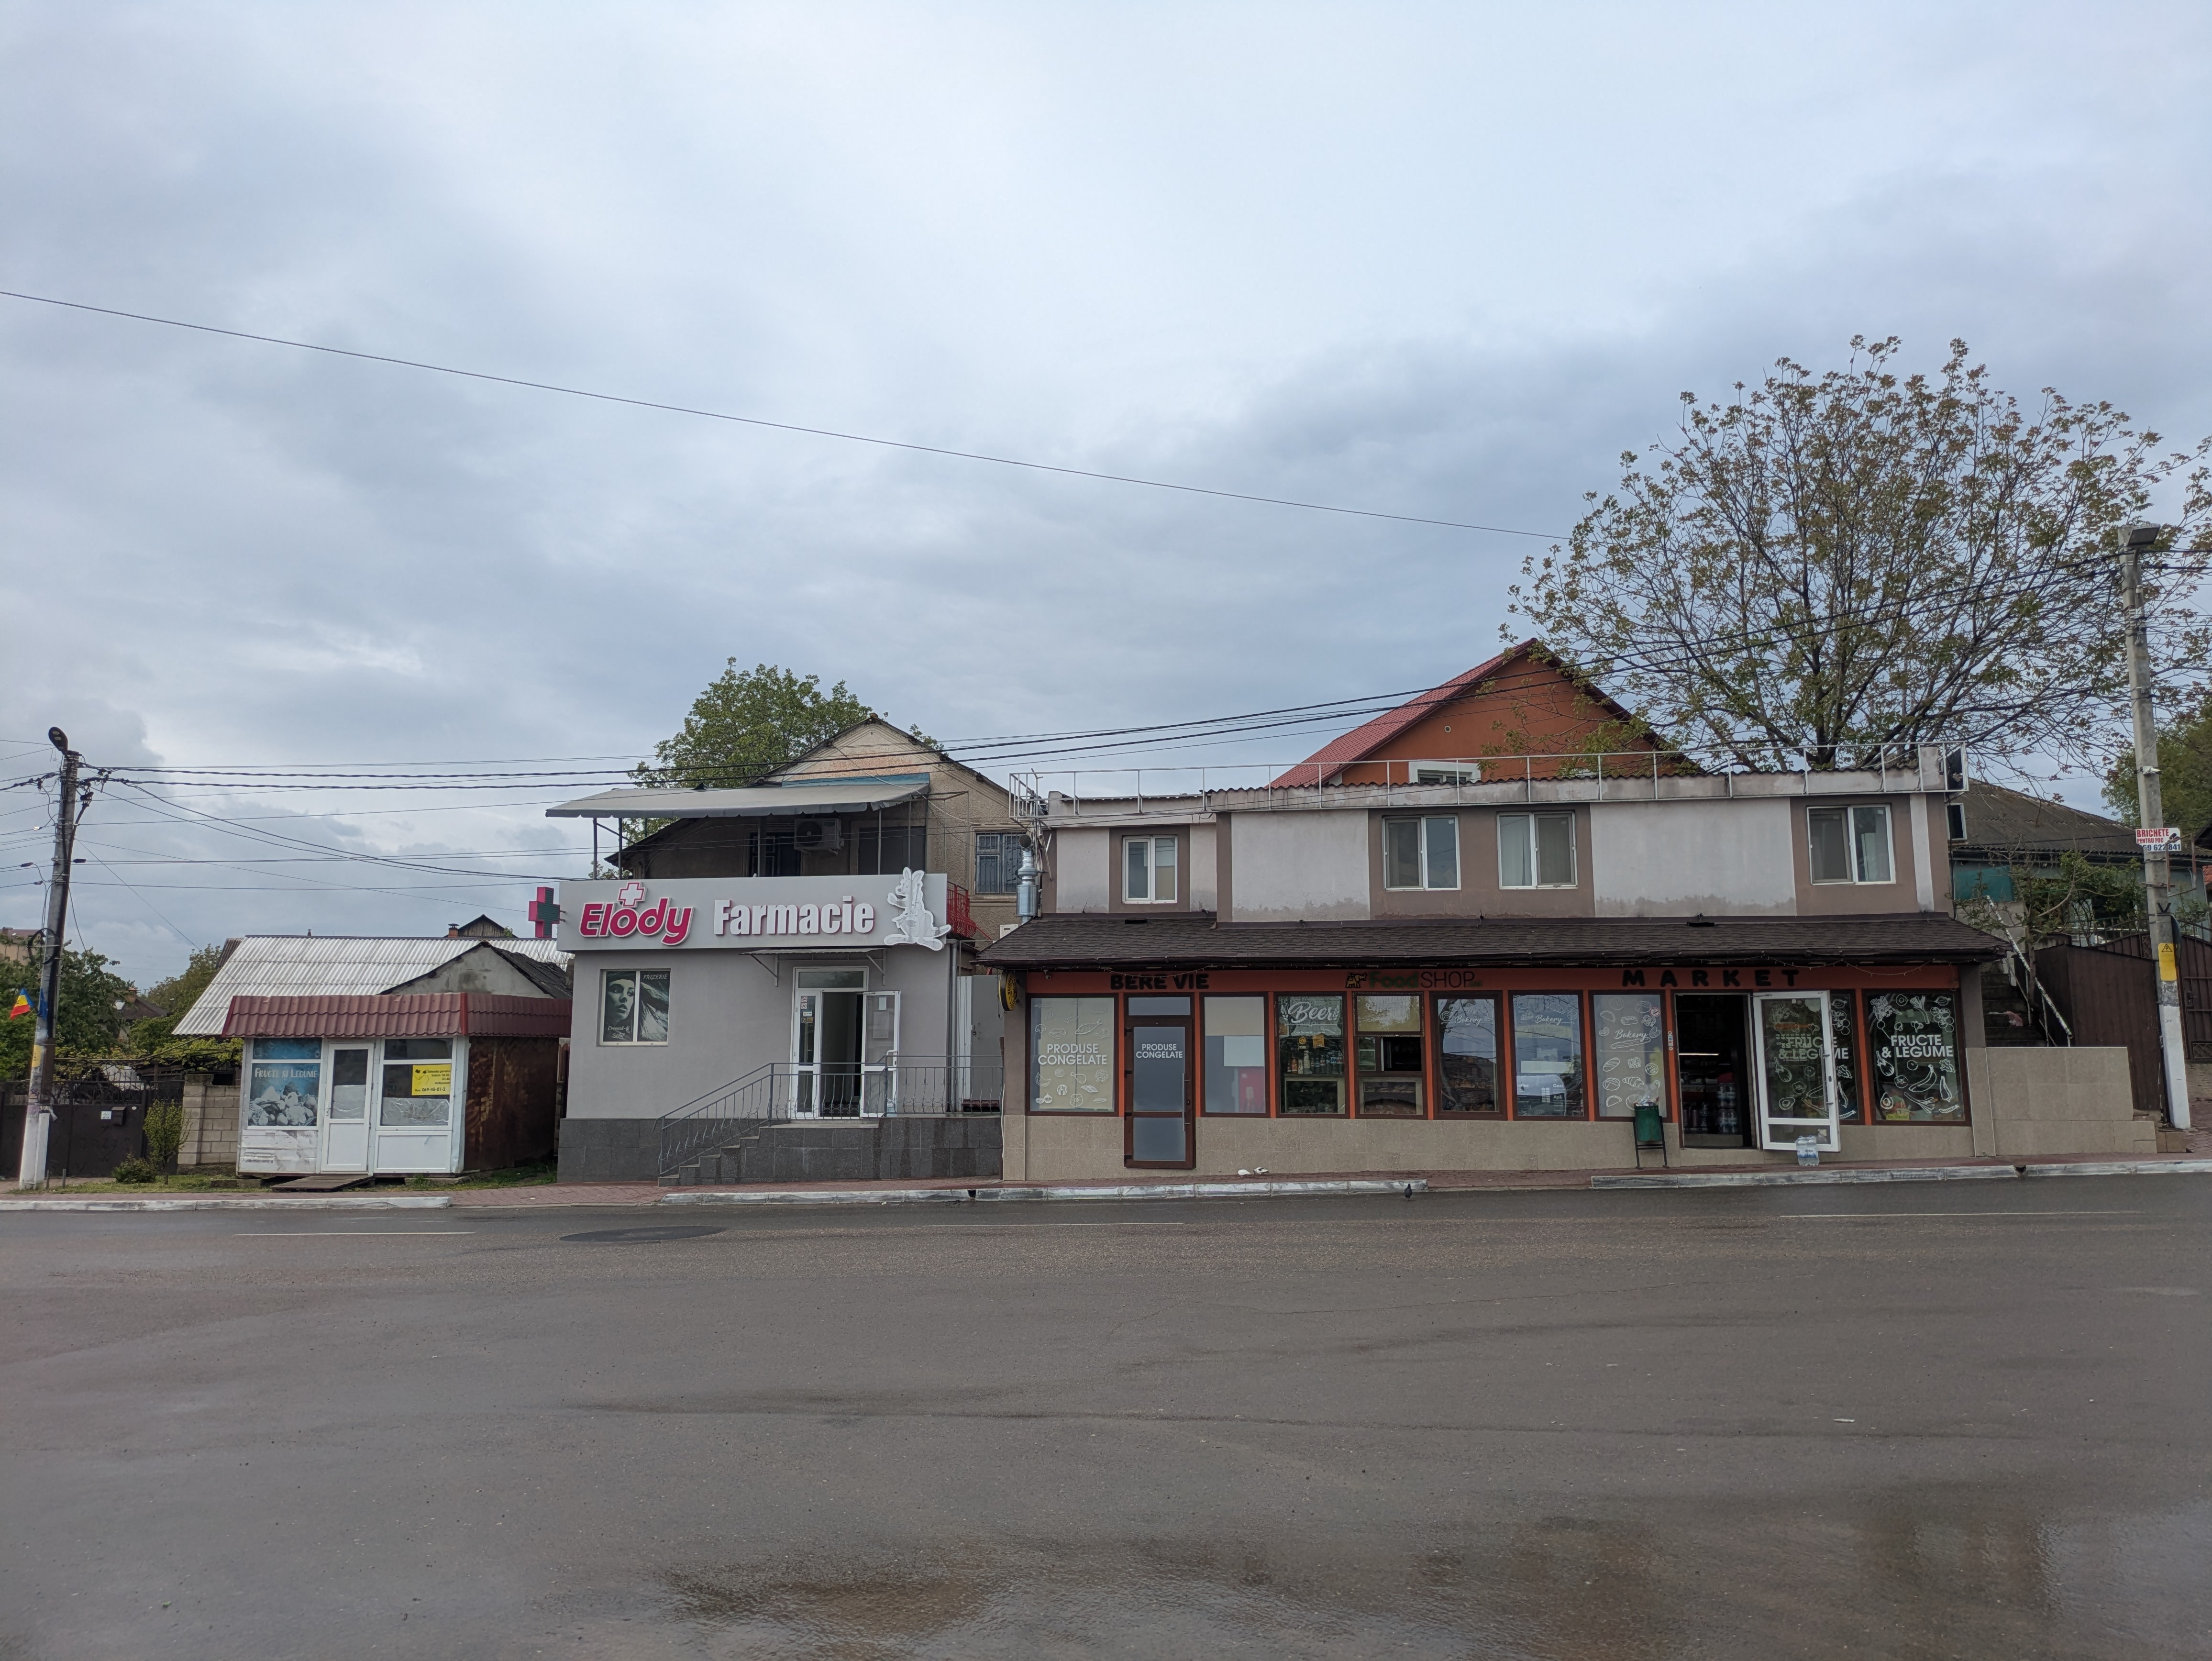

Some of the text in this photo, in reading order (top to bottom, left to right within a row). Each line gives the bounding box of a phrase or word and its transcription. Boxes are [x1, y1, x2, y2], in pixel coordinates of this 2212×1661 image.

[2136, 829, 2169, 837] BRICHETE
[579, 897, 695, 945] Elody
[714, 896, 874, 935] Farmacie
[1110, 974, 1209, 990] BERE VIE
[1622, 970, 1799, 987] MARKET
[1288, 1002, 1333, 1023] Beer
[1455, 1015, 1482, 1026] Bakery
[1535, 1014, 1563, 1025] Bakery
[1615, 1029, 1648, 1042] Bakery
[1891, 1034, 1942, 1046] FRUCTE
[1047, 1043, 1098, 1053] PRODUSE
[1786, 1037, 1837, 1048] FRUCE
[1881, 1046, 1954, 1058] & LEGUME
[1038, 1054, 1107, 1065] CONGELATE
[290, 1069, 318, 1078] LEGUME
